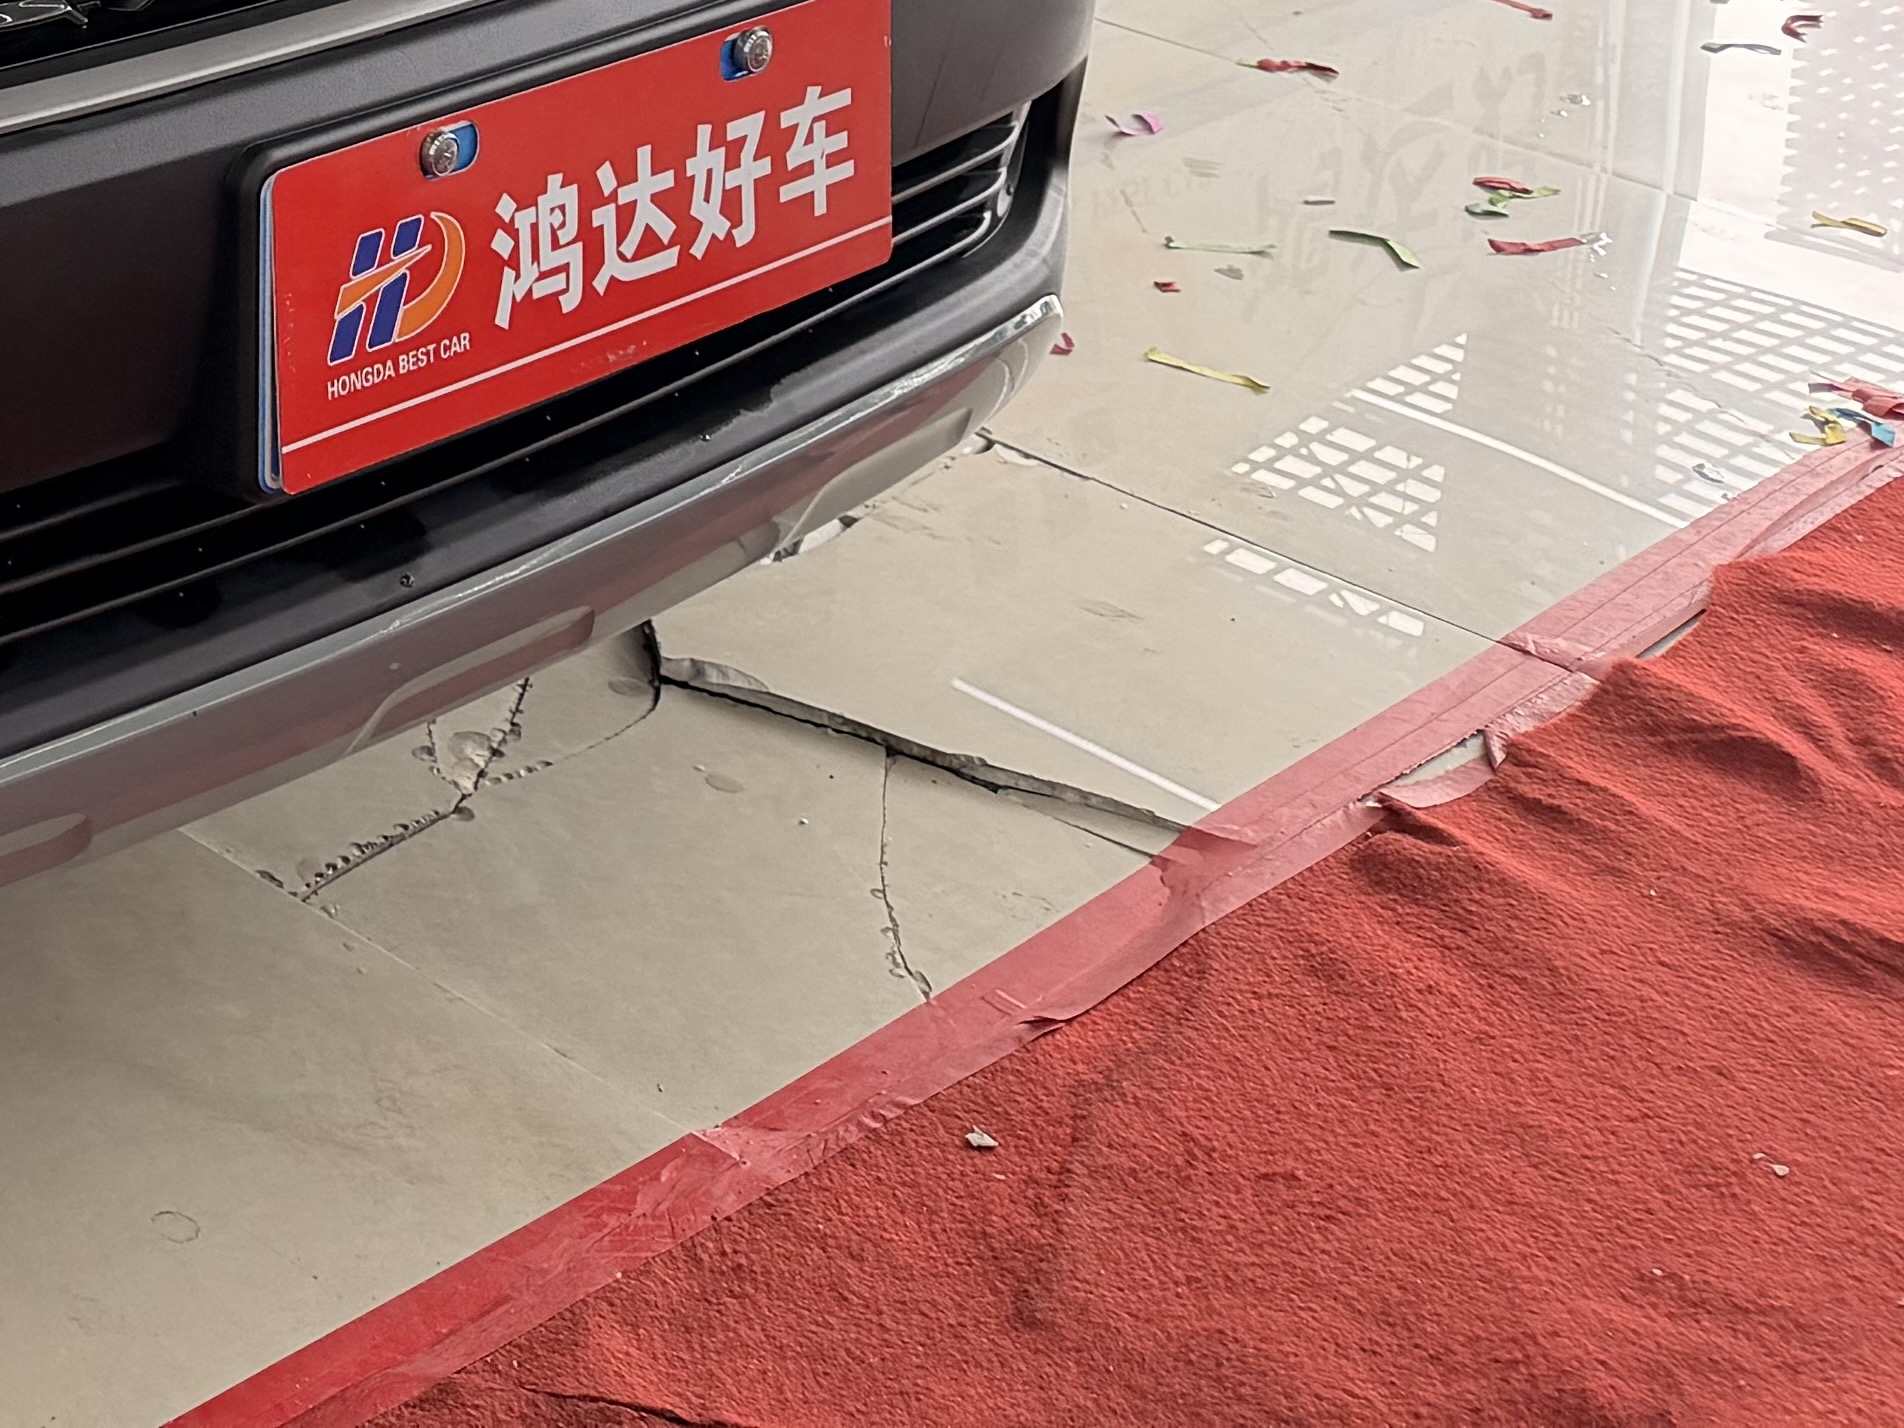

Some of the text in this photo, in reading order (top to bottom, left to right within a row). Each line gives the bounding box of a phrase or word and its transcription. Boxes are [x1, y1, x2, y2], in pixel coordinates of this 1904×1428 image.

[491, 85, 855, 330] 鸿达好车
[327, 332, 471, 400] HONGDA BEST CAR
